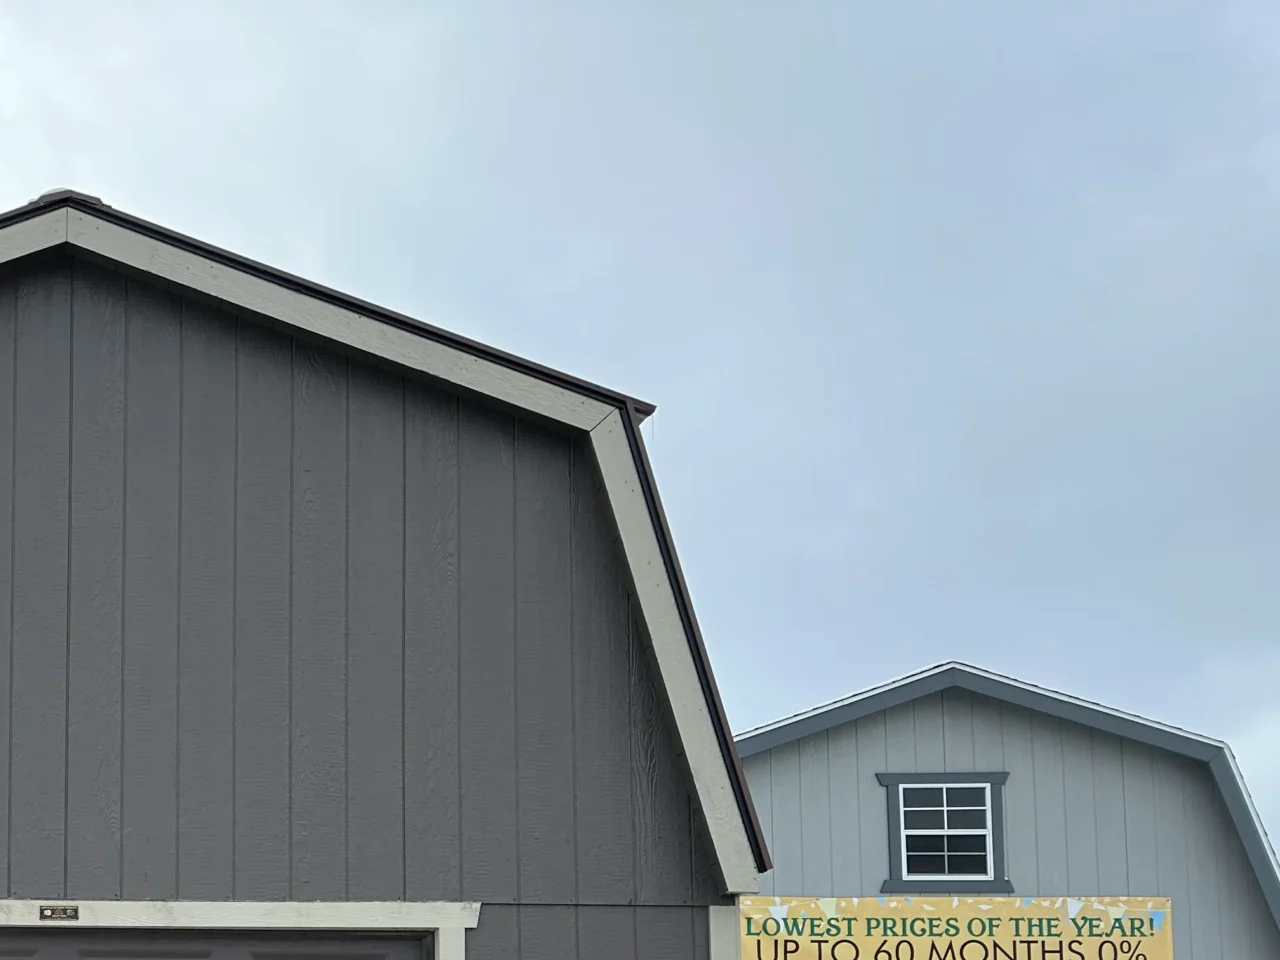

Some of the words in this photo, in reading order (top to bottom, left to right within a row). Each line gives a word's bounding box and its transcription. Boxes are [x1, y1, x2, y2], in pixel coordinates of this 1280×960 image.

[745, 917, 858, 937] LOWEST
[865, 917, 960, 937] PRICES
[967, 917, 1001, 937] OF
[1009, 917, 1062, 938] THE
[1069, 917, 1156, 938] YEAR!
